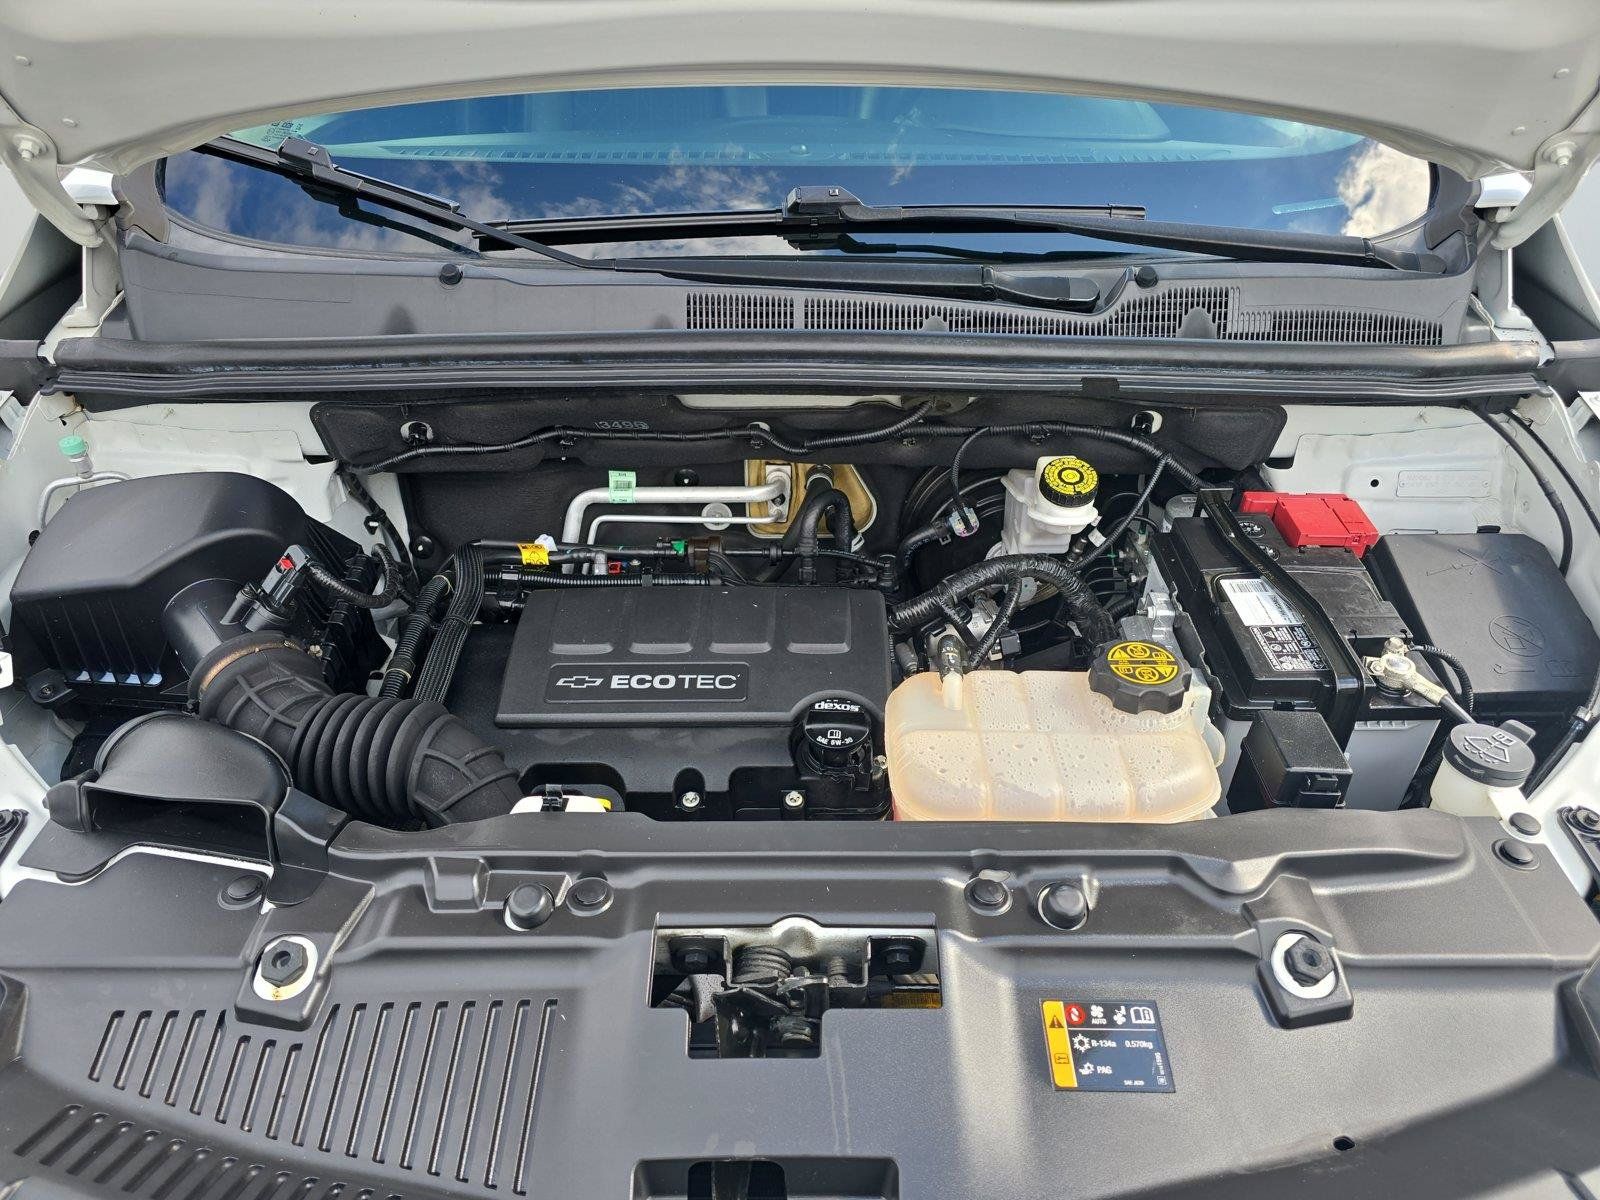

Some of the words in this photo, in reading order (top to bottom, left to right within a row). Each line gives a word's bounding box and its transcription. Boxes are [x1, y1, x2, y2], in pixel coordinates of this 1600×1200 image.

[610, 674, 738, 689] ECOTEC
[814, 701, 861, 712] dexos
[1124, 1040, 1153, 1049] 0.570kg
[1097, 1065, 1112, 1074] PAG
